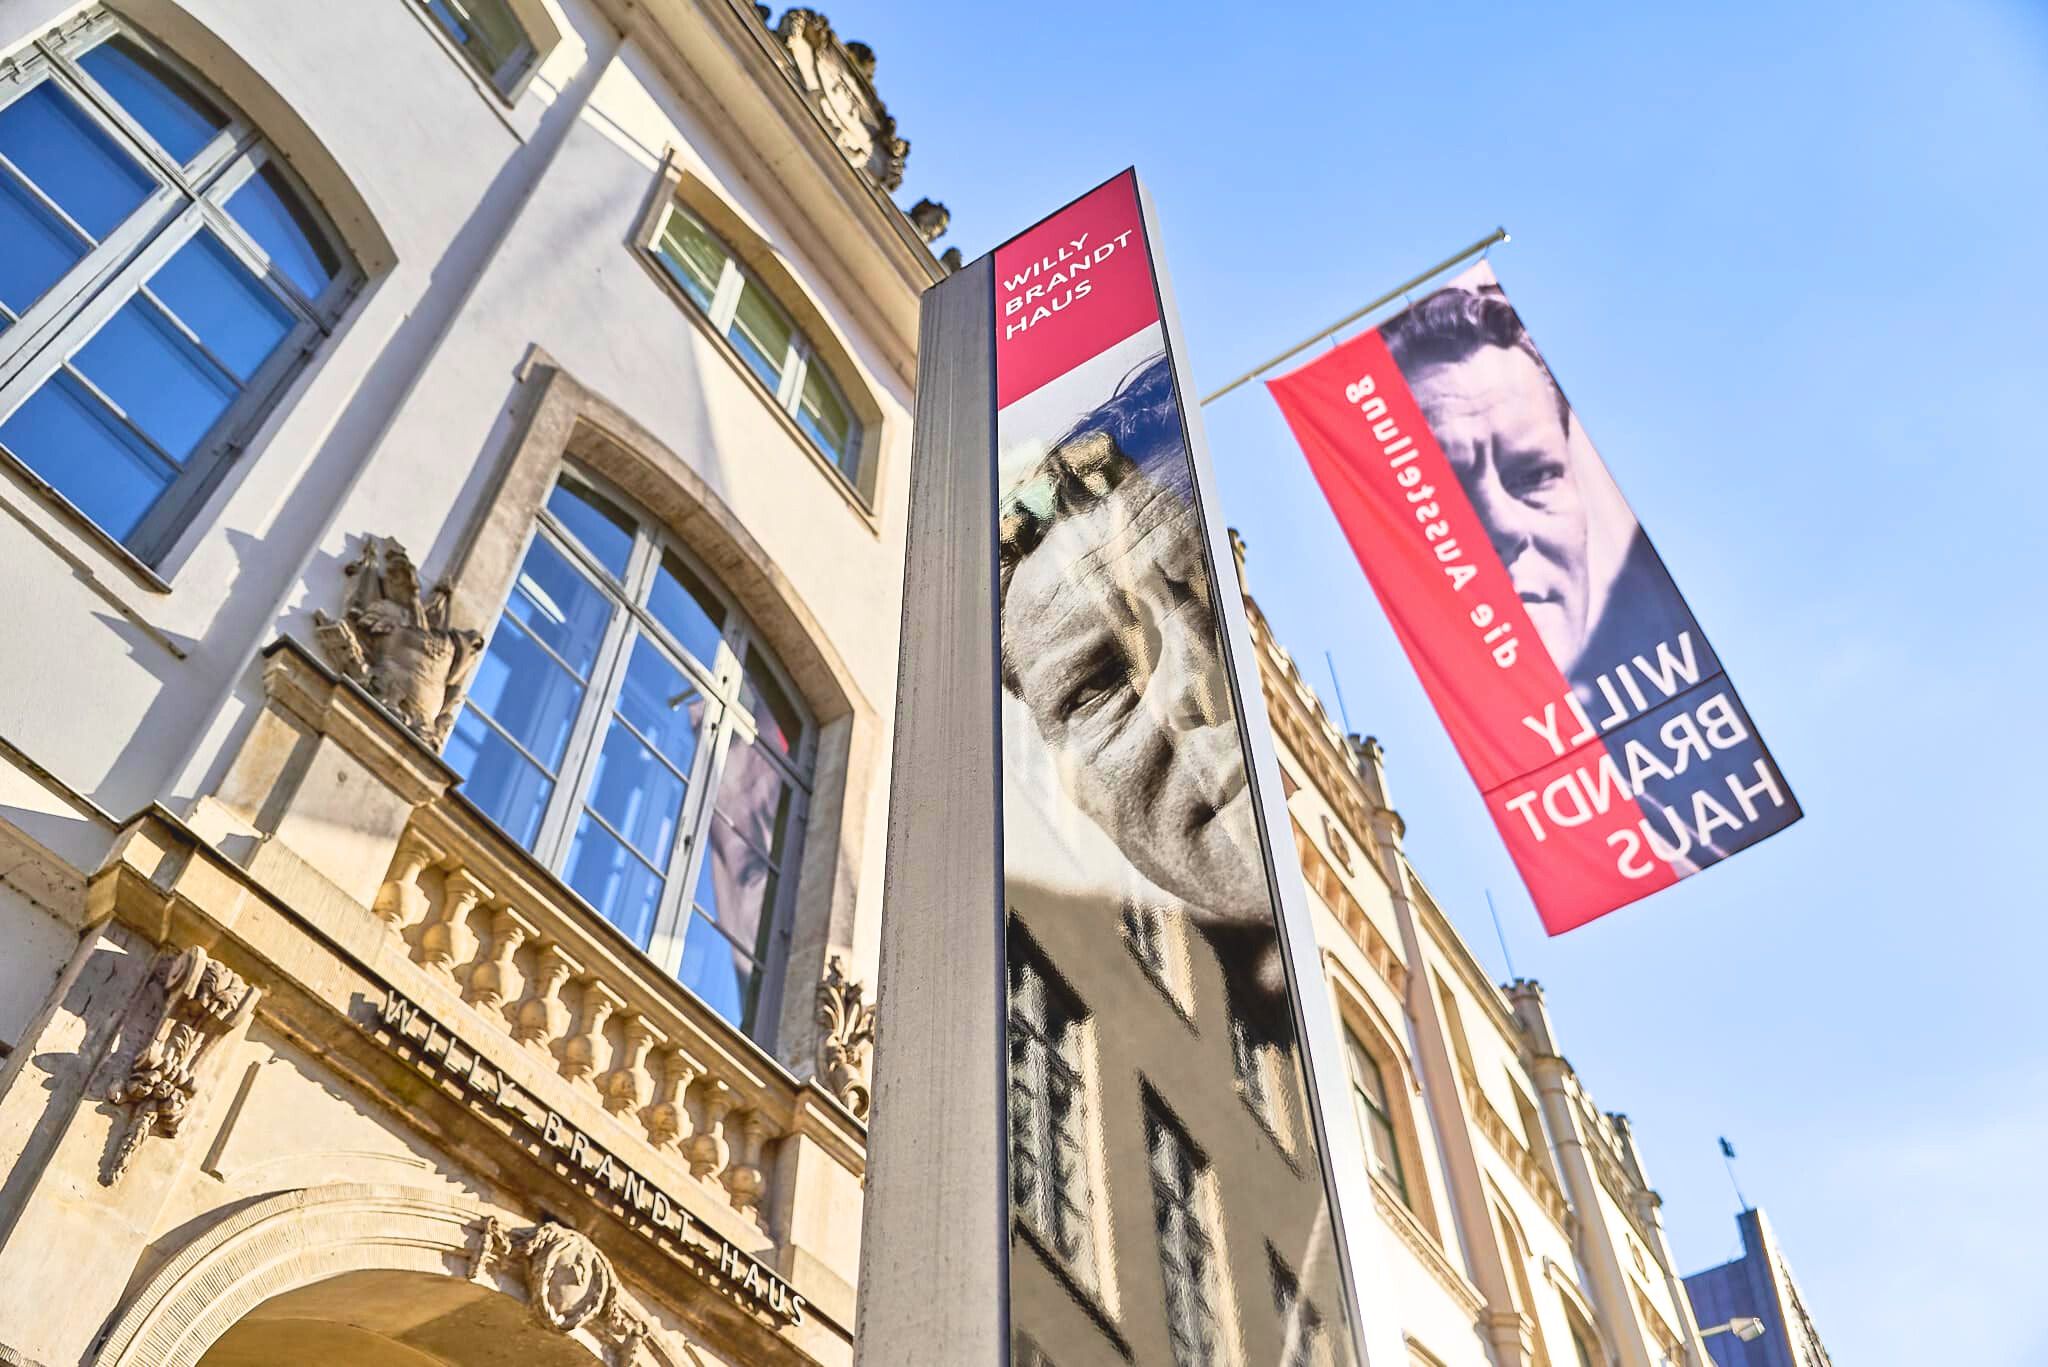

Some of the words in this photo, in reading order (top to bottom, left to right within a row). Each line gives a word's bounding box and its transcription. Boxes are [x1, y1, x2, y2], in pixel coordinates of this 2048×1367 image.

[1003, 232, 1088, 292] WILLY
[1006, 229, 1132, 317] BRANDT
[1006, 279, 1092, 341] HAUS
[384, 989, 516, 1106] WILLY
[543, 1110, 694, 1244] BRANDT
[720, 1241, 806, 1328] HAUS
